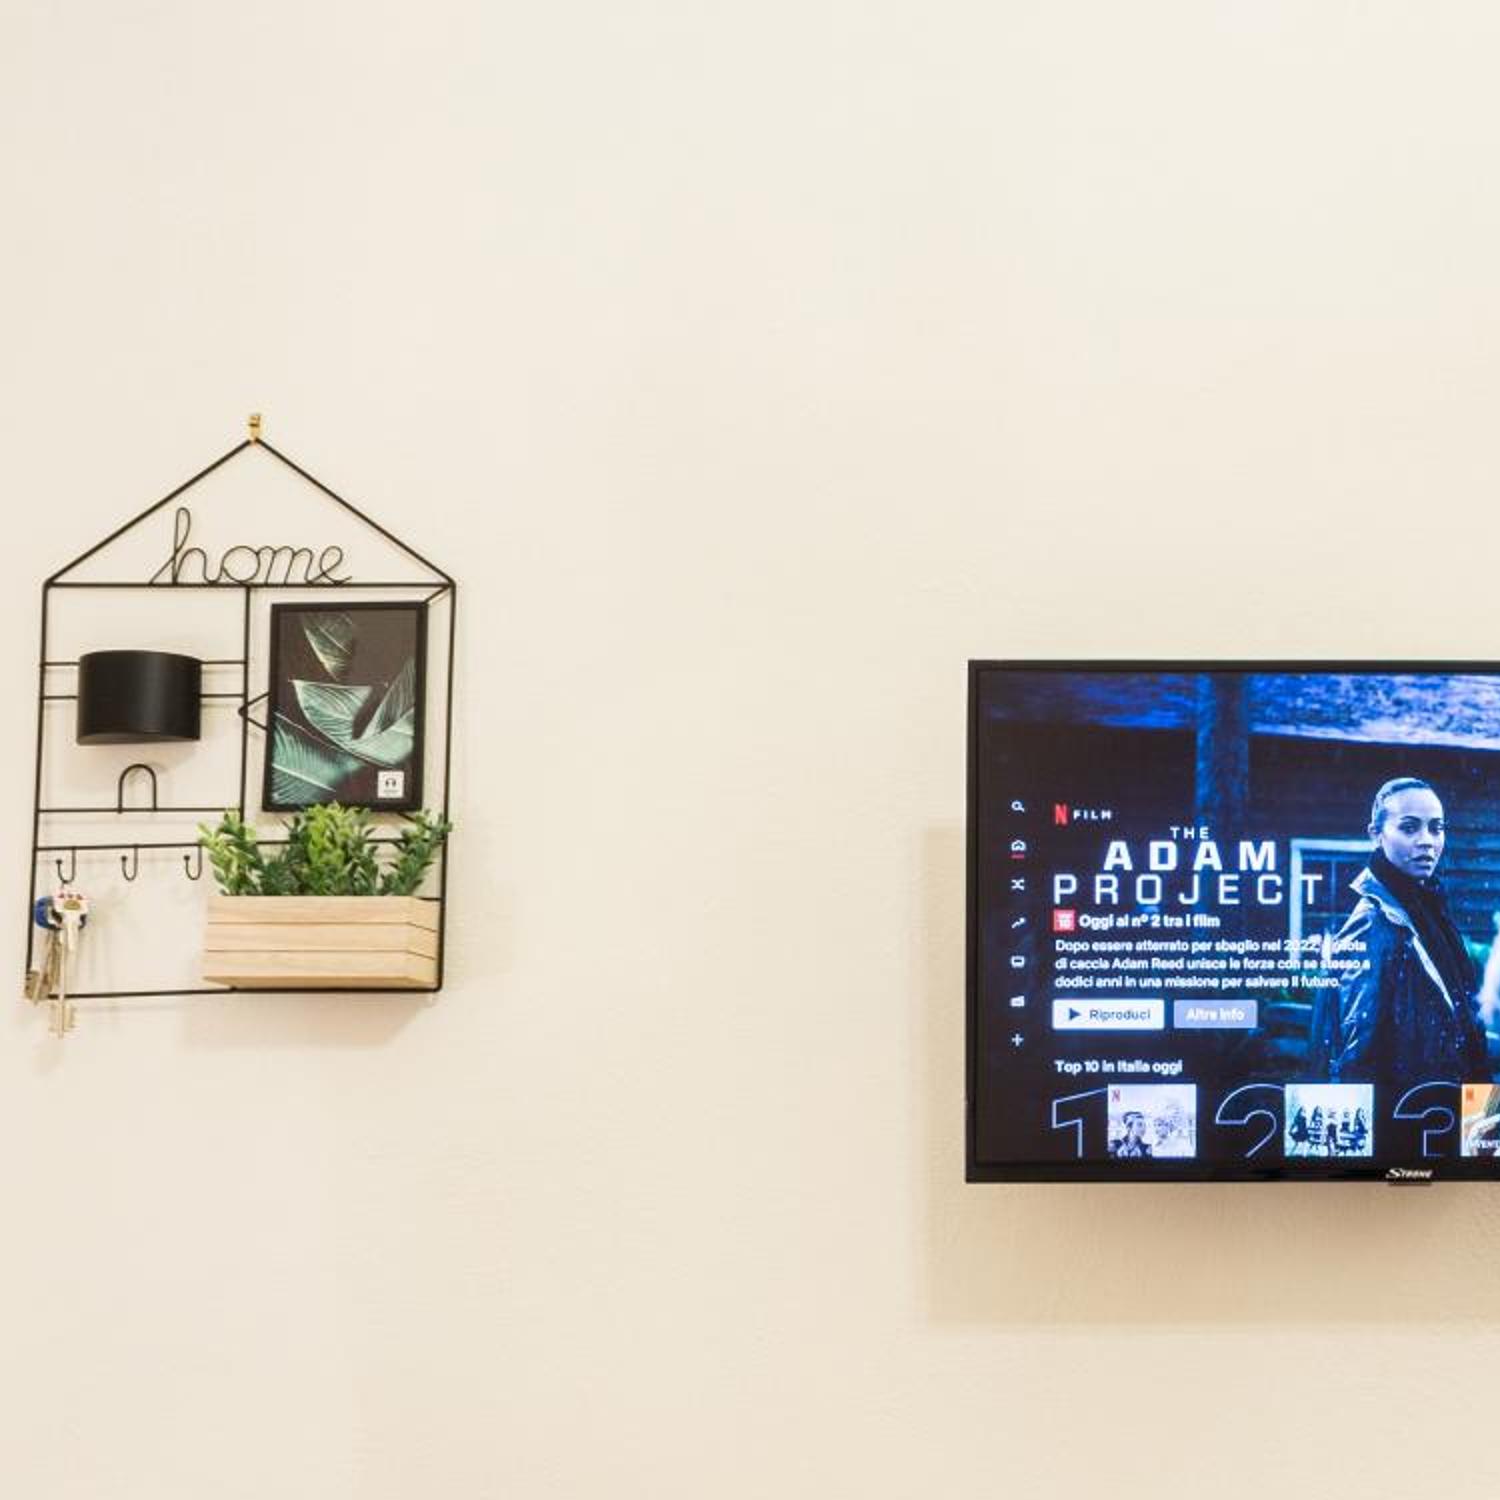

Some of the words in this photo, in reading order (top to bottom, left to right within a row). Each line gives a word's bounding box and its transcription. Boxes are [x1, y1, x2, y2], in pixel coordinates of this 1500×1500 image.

[150, 507, 352, 585] home
[1073, 810, 1112, 820] FILM
[1169, 826, 1209, 840] THE
[1103, 840, 1276, 871] ADAM
[1053, 874, 1323, 905] PROJECT
[1079, 914, 1114, 930] Oggi
[1151, 914, 1161, 927] 2
[1163, 914, 1184, 927] tra
[1193, 914, 1221, 927] film
[1055, 940, 1090, 954] Dopo
[1092, 942, 1132, 952] essere
[1135, 940, 1189, 952] atterrato
[1192, 942, 1211, 954] per
[1215, 939, 1260, 954] sbaglio
[1262, 939, 1281, 952] nel
[1055, 957, 1067, 969] di
[1070, 957, 1110, 969] caccia
[1112, 957, 1148, 969] Adam
[1151, 957, 1184, 969] Reed
[1187, 957, 1227, 969] unisce
[1229, 957, 1241, 969] le
[1277, 959, 1300, 970] con
[1303, 959, 1317, 970] se
[1055, 975, 1093, 987] dodici
[1095, 976, 1122, 987] anni
[1125, 976, 1136, 987] in
[1139, 978, 1162, 987] una
[1165, 976, 1219, 987] missione
[1222, 977, 1243, 990] per
[1245, 975, 1289, 988] salvare
[1089, 1008, 1151, 1022] Riproduci
[1186, 1008, 1217, 1021] Altre
[1055, 1060, 1082, 1075] Top
[1084, 1060, 1100, 1073] 10
[1102, 1060, 1115, 1073] in
[1117, 1060, 1150, 1073] Italia
[1152, 1060, 1183, 1074] oggi
